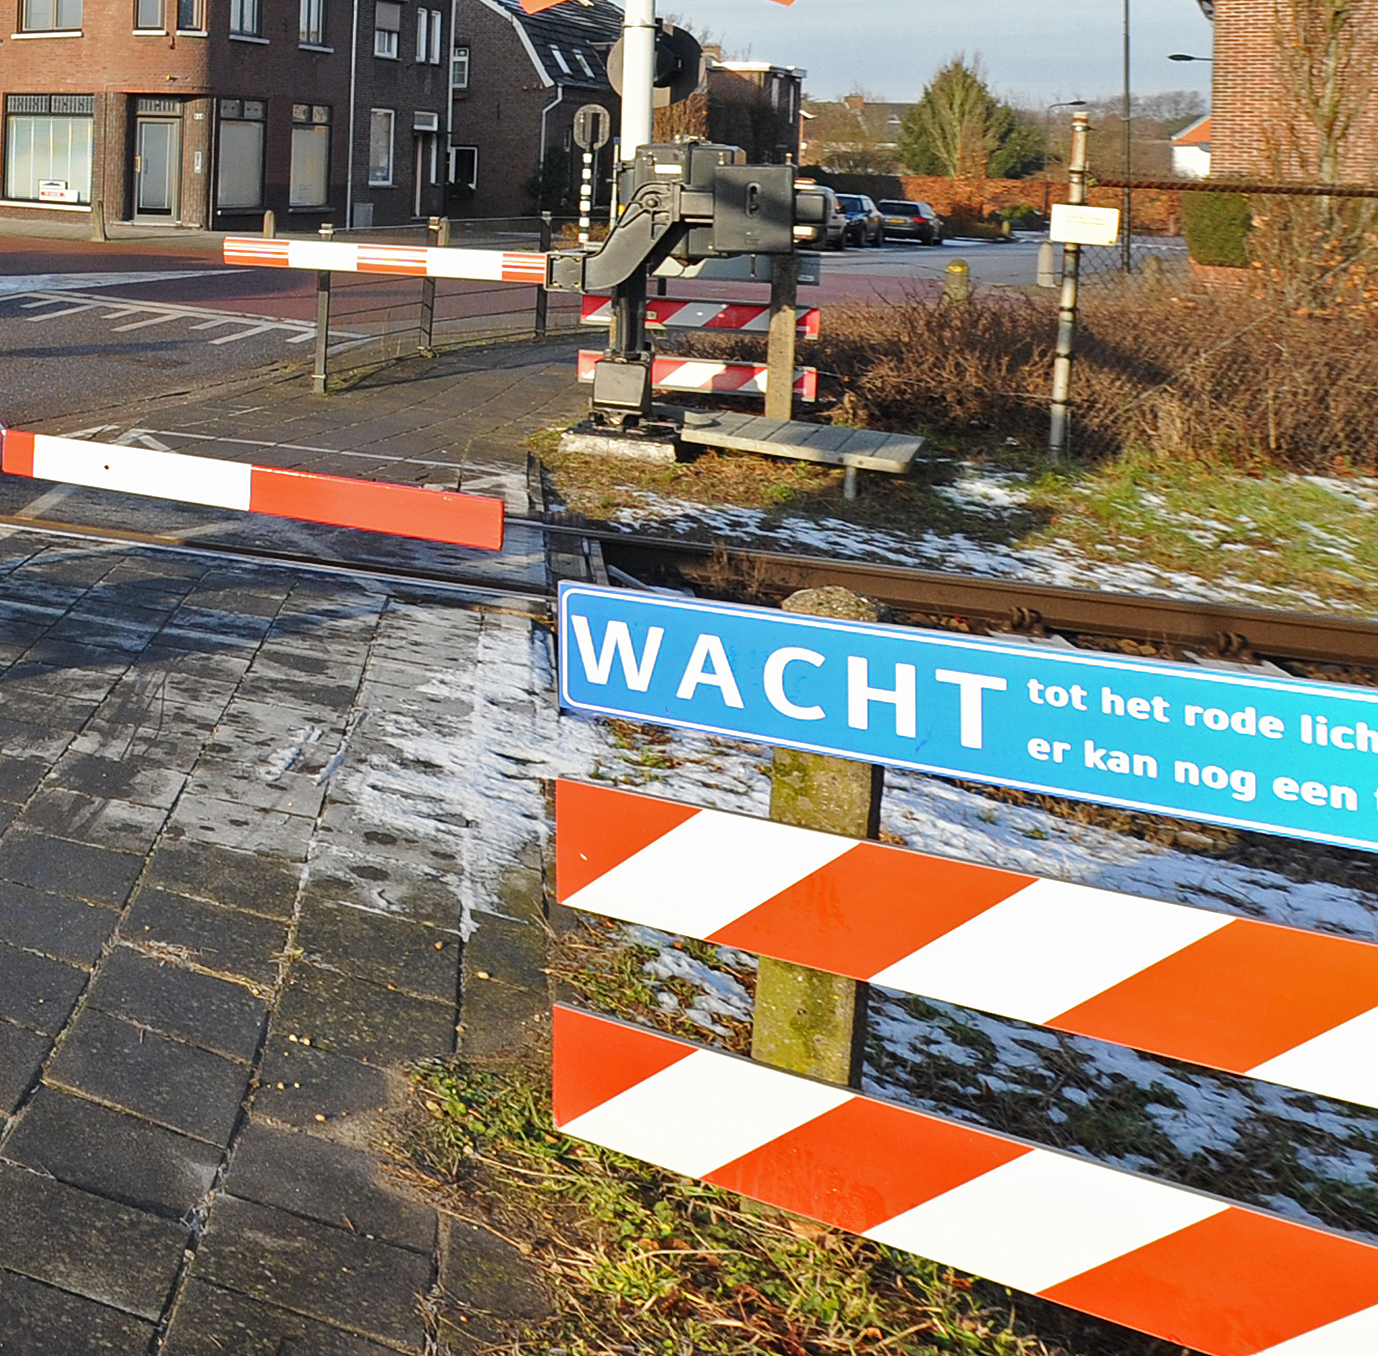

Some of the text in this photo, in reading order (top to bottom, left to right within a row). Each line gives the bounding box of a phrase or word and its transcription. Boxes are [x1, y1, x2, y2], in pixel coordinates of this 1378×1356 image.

[571, 614, 1008, 750] WACHT
[1027, 678, 1088, 711] tot
[1101, 686, 1170, 723] het
[1184, 706, 1285, 739] rode
[1027, 737, 1071, 763] er
[1084, 739, 1158, 779] kan
[1174, 760, 1256, 802] nog
[1272, 776, 1358, 812] een
